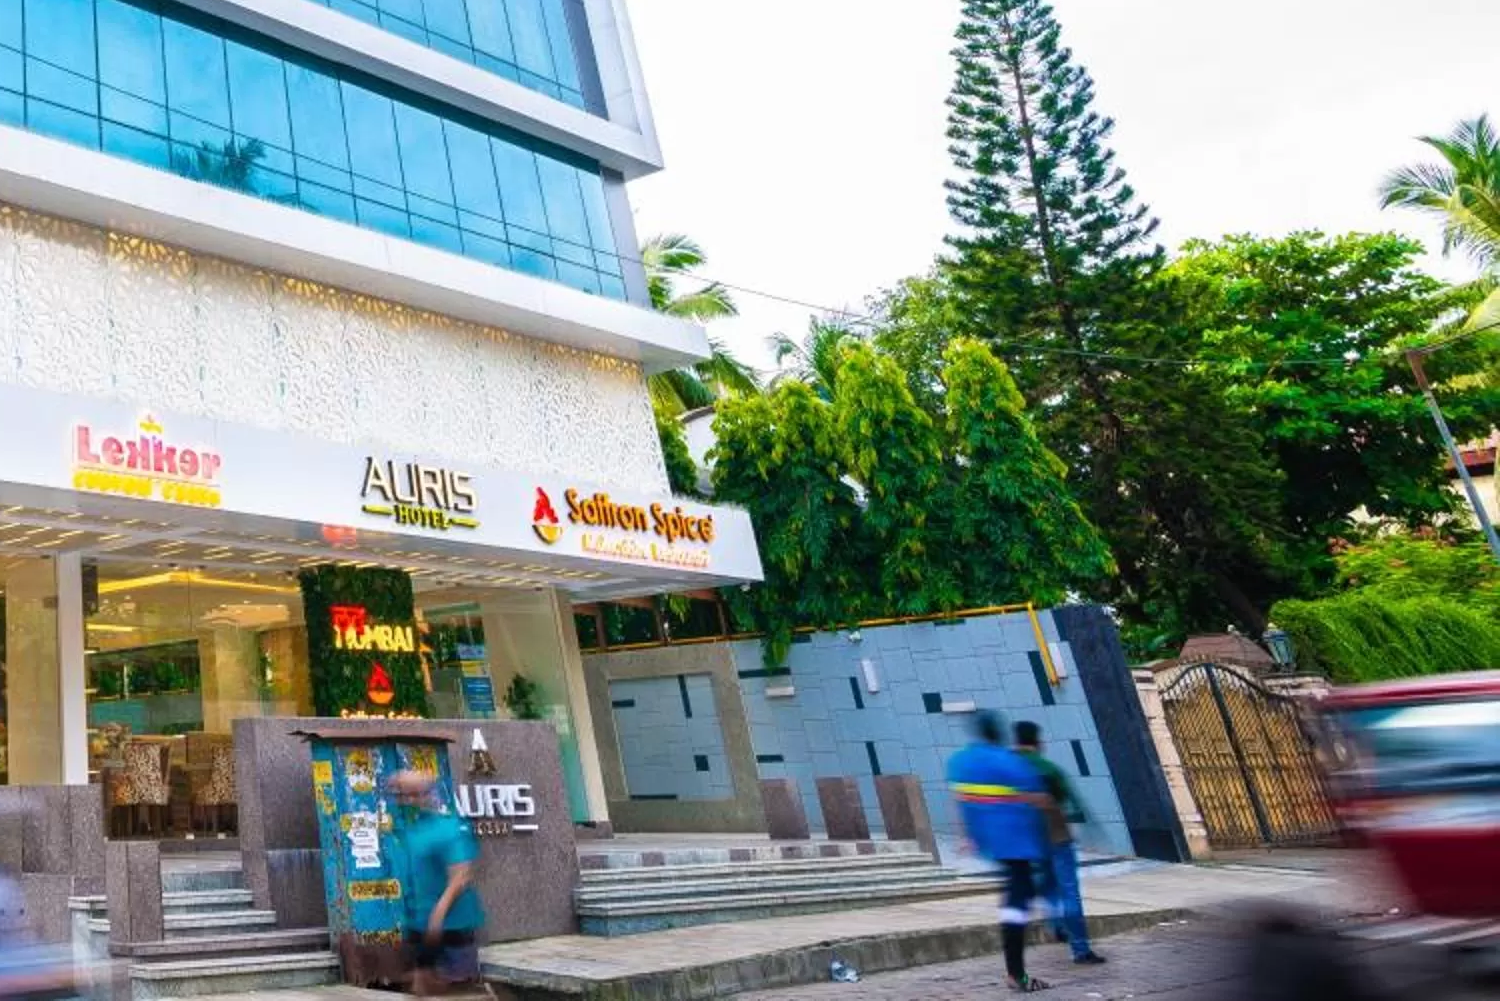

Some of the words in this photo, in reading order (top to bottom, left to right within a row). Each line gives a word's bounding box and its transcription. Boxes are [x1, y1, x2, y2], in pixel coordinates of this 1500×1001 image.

[361, 456, 478, 514] AURIS
[393, 504, 450, 531] HOTEL
[564, 487, 648, 532] Saffron
[650, 502, 716, 544] Spice
